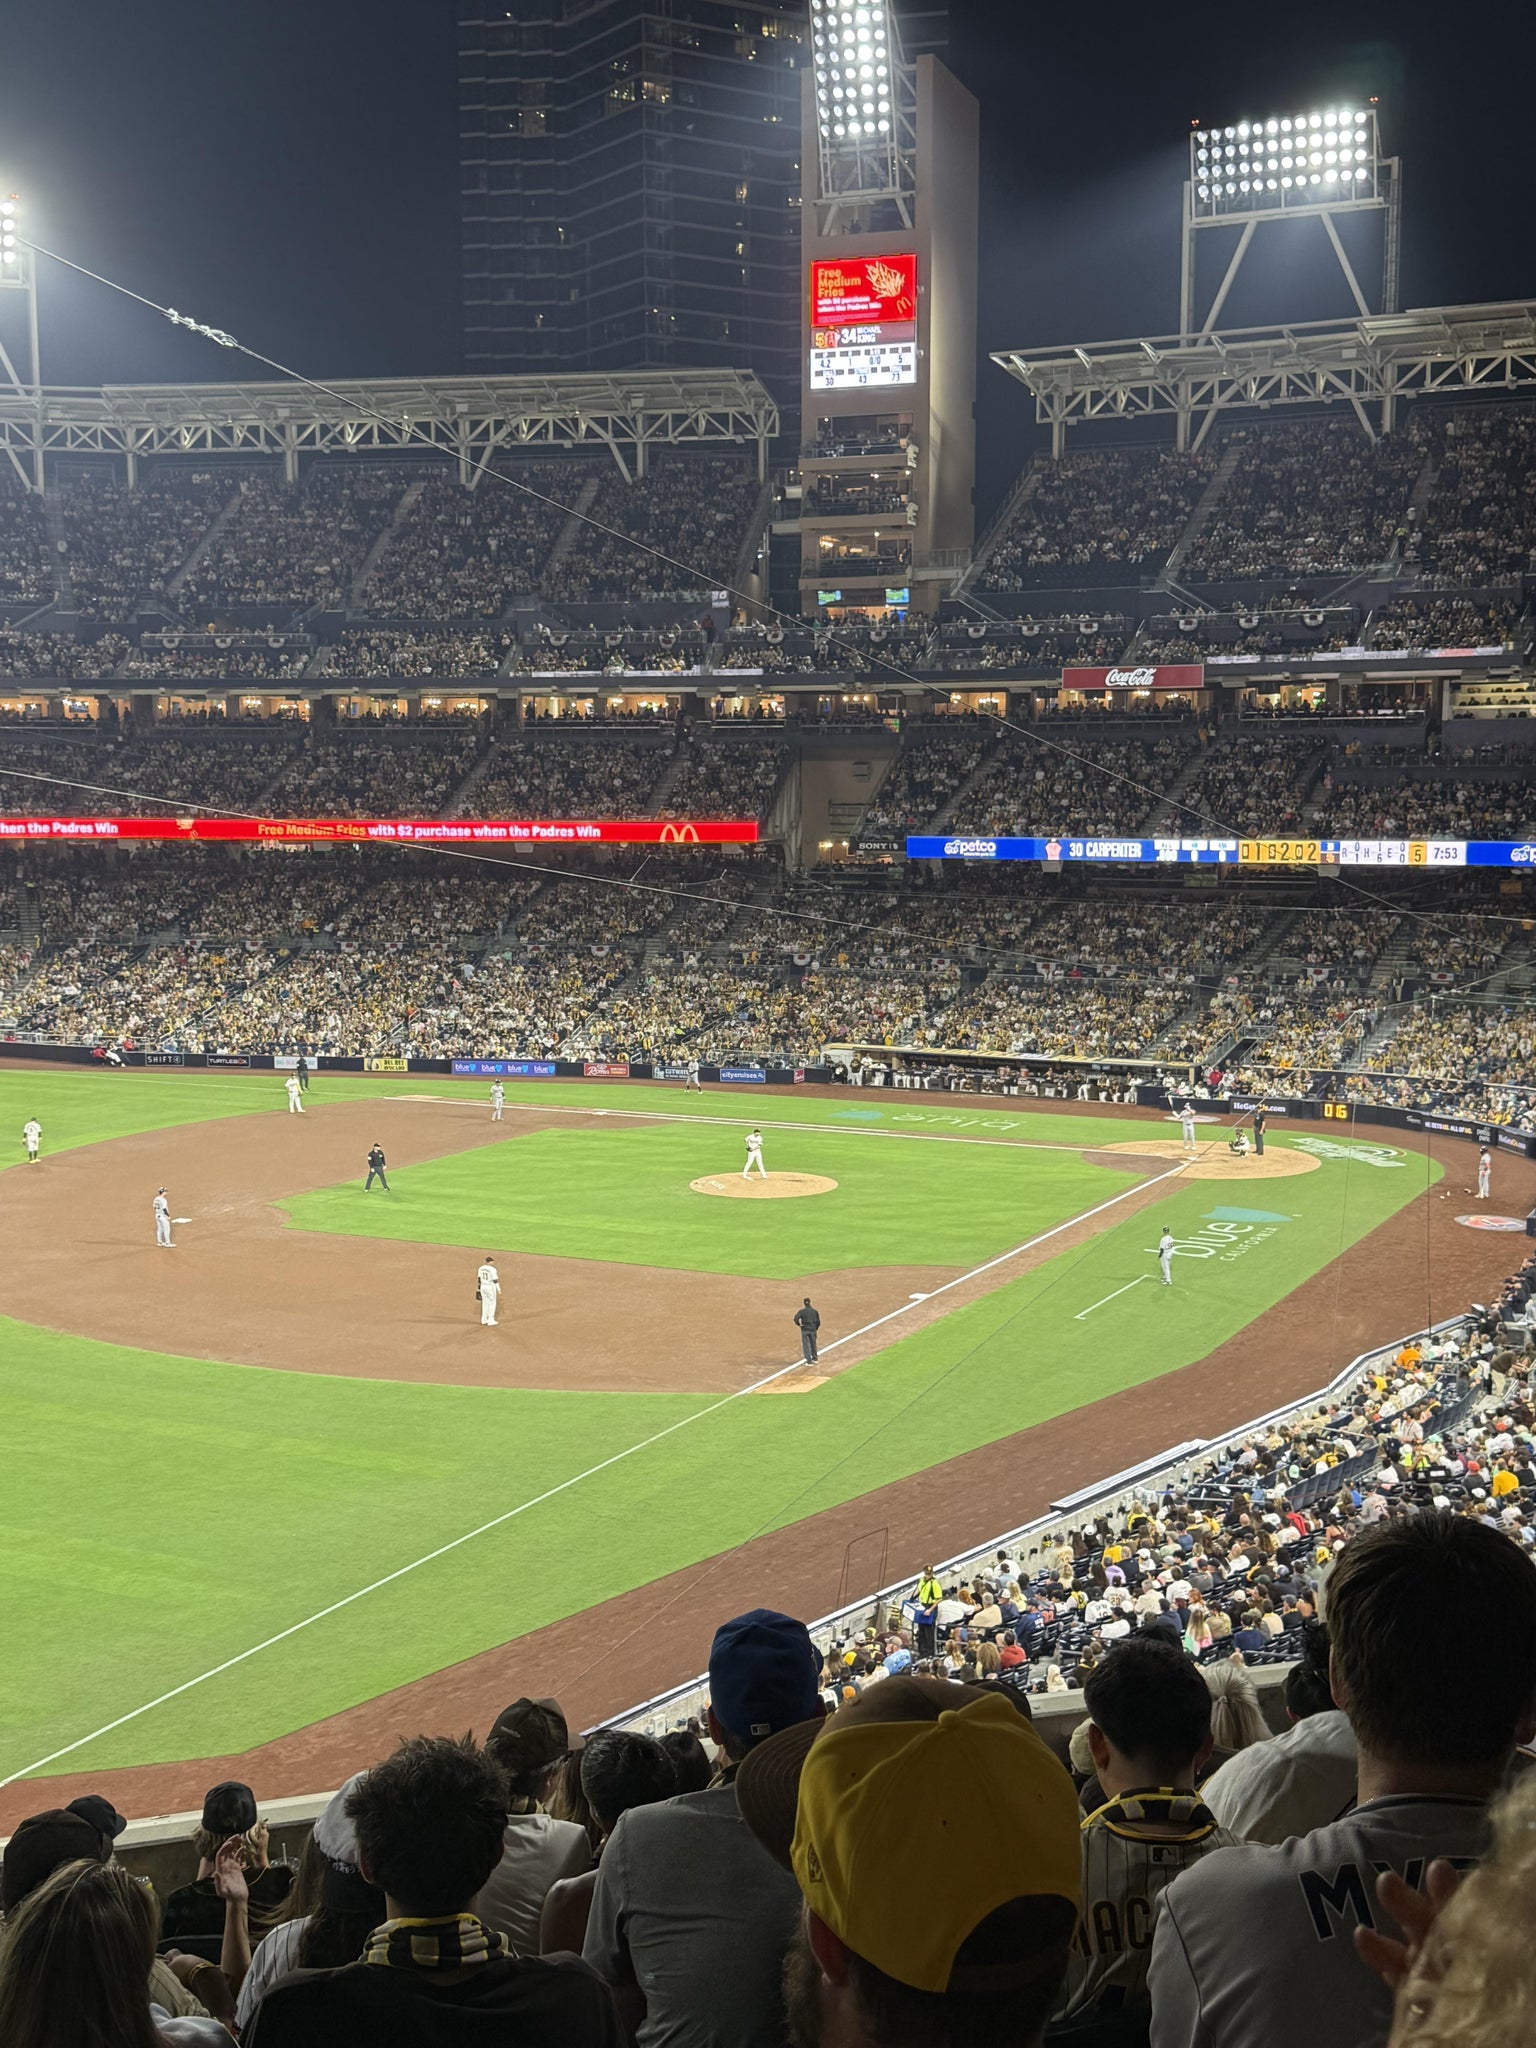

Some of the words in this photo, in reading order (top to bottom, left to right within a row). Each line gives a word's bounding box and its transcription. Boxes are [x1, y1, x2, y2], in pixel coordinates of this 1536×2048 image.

[818, 268, 841, 278] Free
[818, 276, 861, 287] Medium
[818, 286, 844, 298] Fries
[1105, 668, 1157, 687] Coca-Cola
[0, 823, 25, 834] hen
[27, 823, 50, 833] the
[52, 822, 93, 833] Padres
[95, 822, 118, 833] Win
[258, 824, 284, 835] Free
[286, 824, 334, 835] Medium
[336, 824, 366, 835] Fries
[367, 824, 395, 836] with
[397, 824, 413, 837] $2
[415, 825, 471, 838] purchase
[473, 825, 506, 836] when
[509, 825, 530, 836] the
[532, 825, 574, 837] Padres
[576, 825, 601, 837] Win
[960, 840, 996, 854] petco
[1069, 843, 1083, 857] 30
[1086, 843, 1142, 857] CARPENTER
[1256, 843, 1260, 860] 1
[1281, 843, 1289, 861] 2
[1308, 843, 1316, 861] 2
[1355, 842, 1359, 851] 0
[1364, 848, 1369, 858] H
[1387, 848, 1392, 858] E
[1400, 842, 1405, 851] 0
[1434, 847, 1457, 859] 7:53
[1377, 854, 1382, 863] 6
[1400, 854, 1405, 863] 0
[1414, 849, 1421, 862] 5
